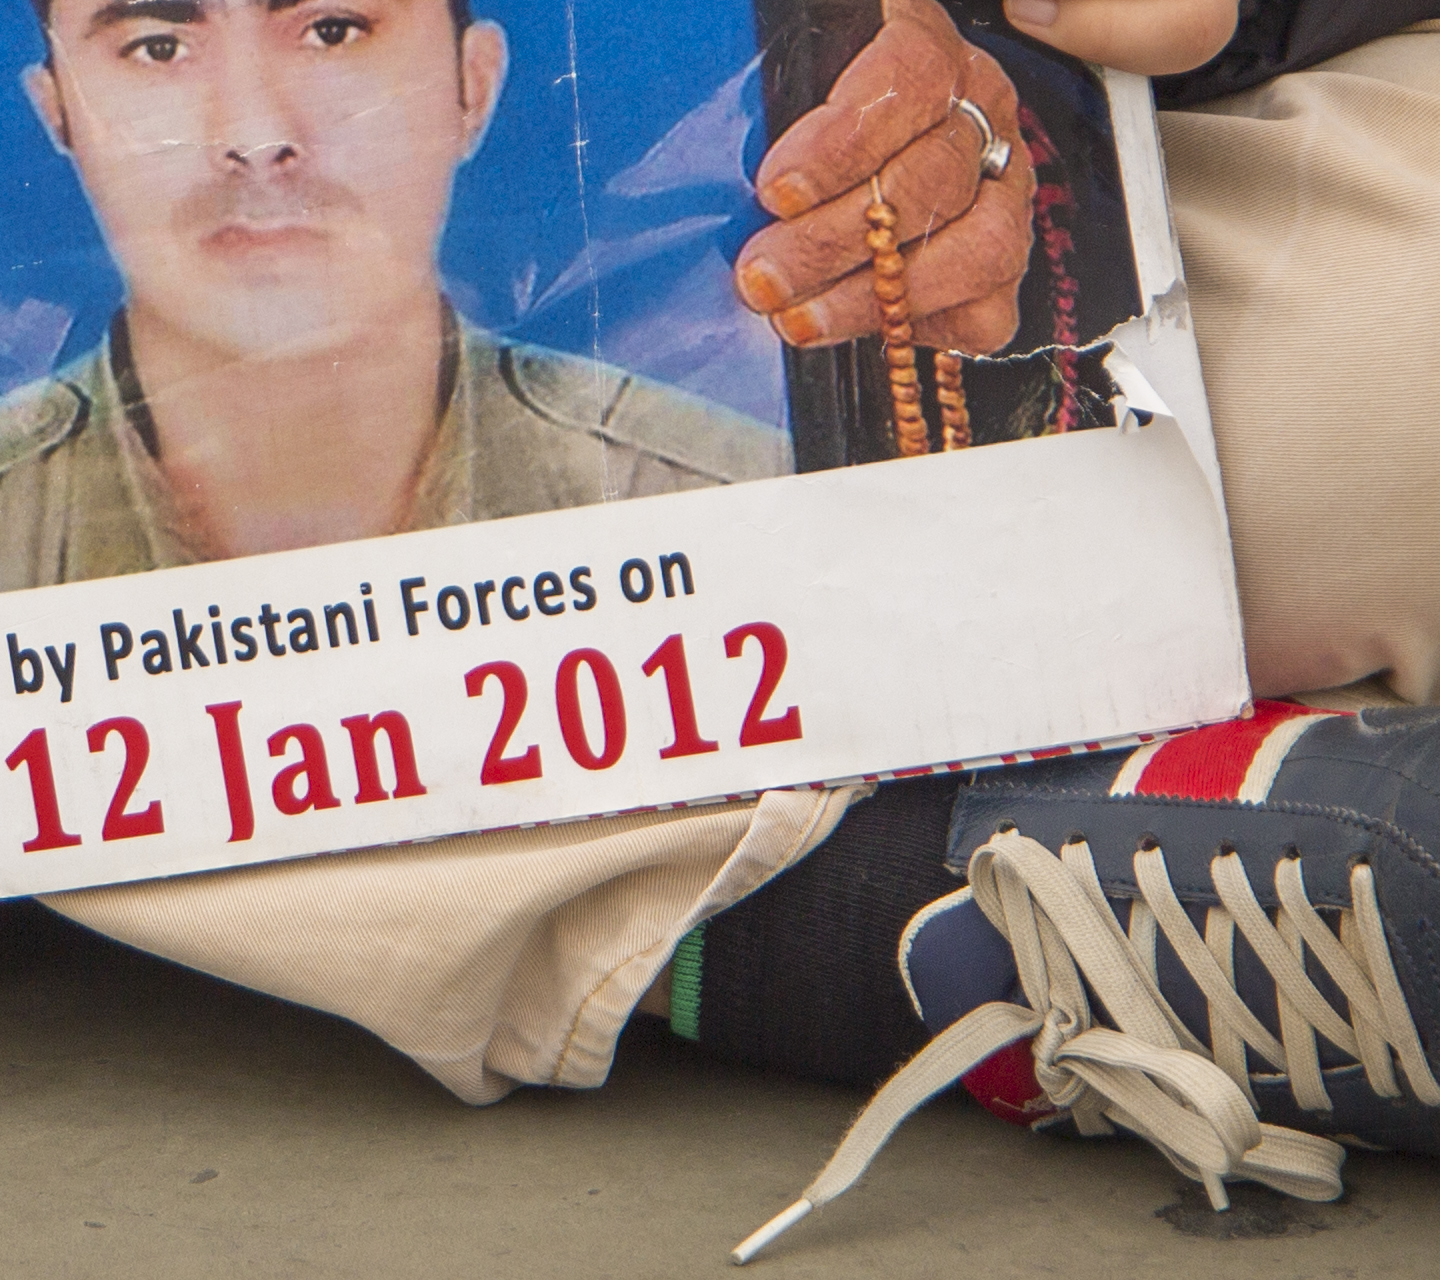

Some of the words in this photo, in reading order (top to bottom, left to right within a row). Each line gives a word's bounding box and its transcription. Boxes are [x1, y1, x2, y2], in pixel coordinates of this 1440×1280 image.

[6, 630, 78, 703] by
[100, 580, 381, 683] Pakistani
[401, 573, 599, 637] Forces
[618, 550, 696, 600] on
[4, 718, 167, 855] 12
[204, 698, 429, 845] Jan
[463, 620, 805, 788] 2012
